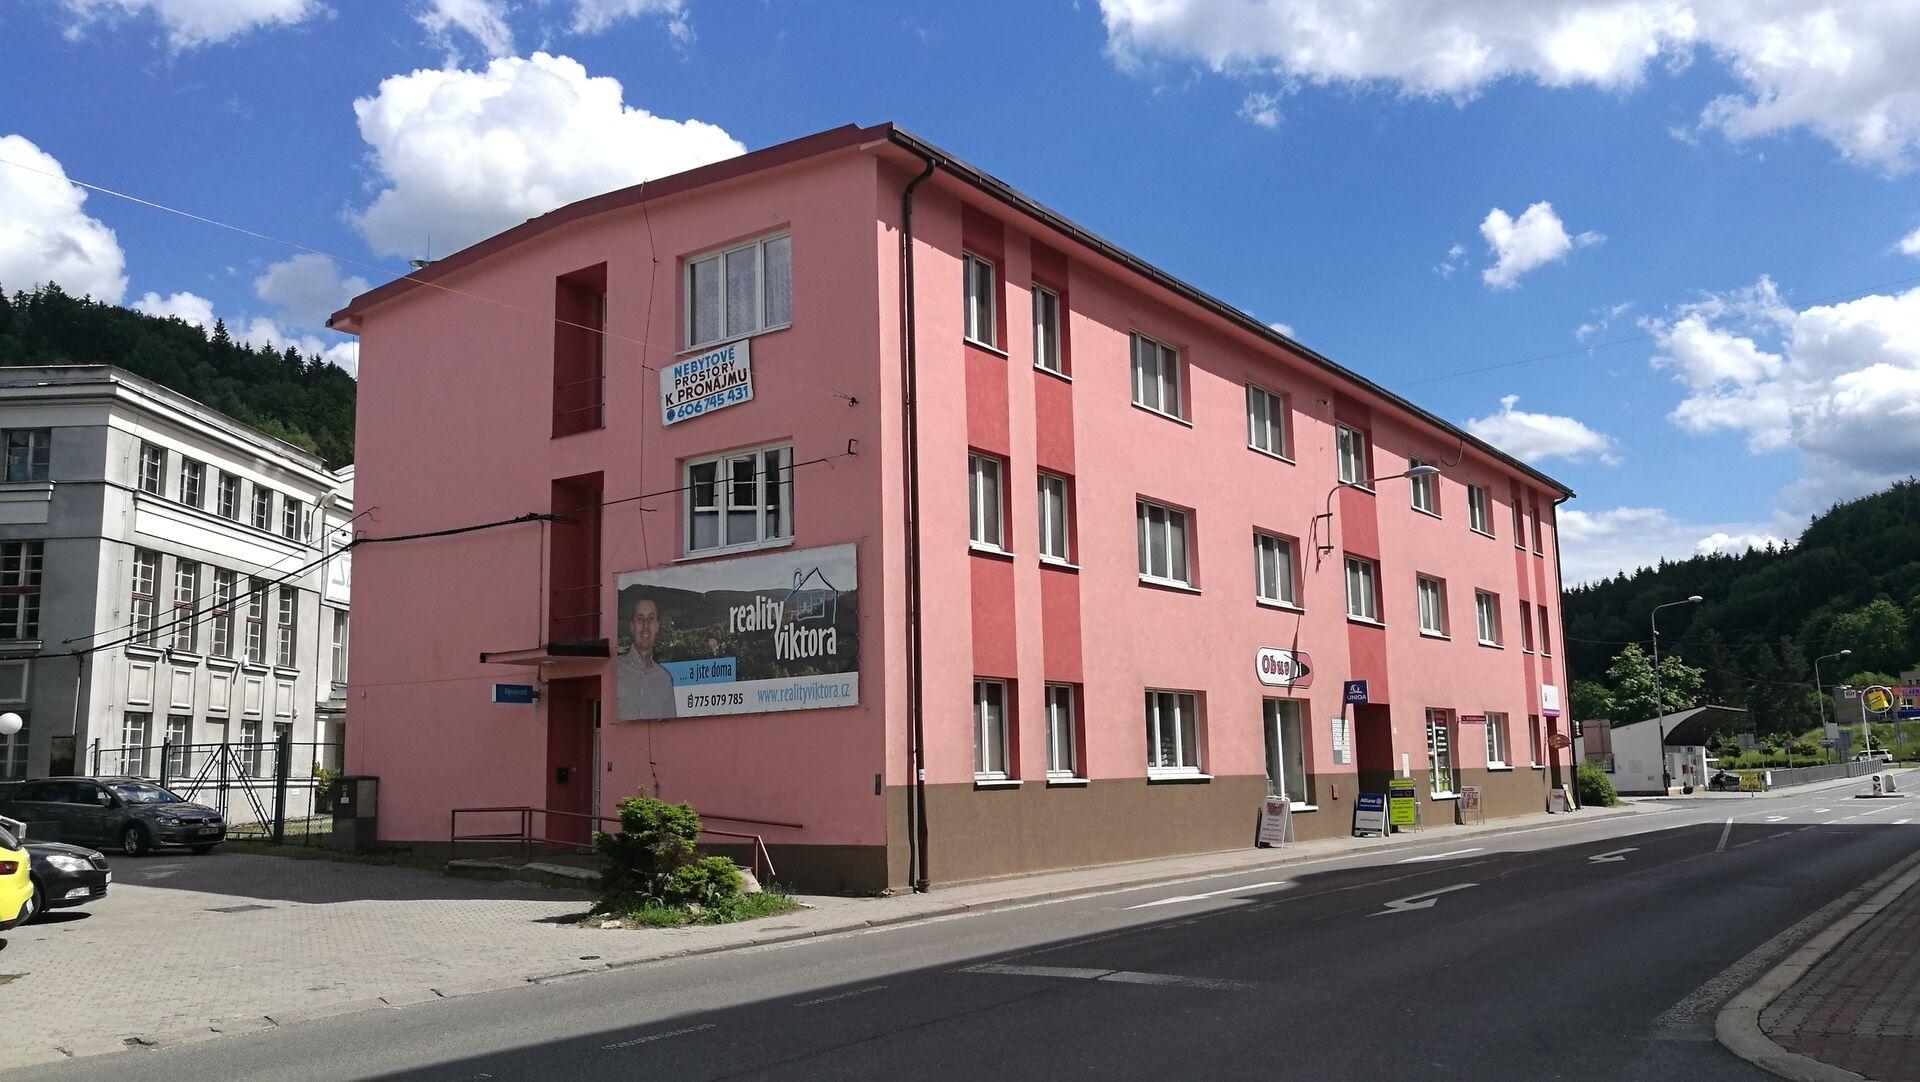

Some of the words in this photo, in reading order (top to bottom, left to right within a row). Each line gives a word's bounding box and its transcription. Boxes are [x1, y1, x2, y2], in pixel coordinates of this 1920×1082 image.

[675, 360, 735, 389] PROSTORY
[665, 393, 674, 406] K
[677, 401, 703, 418] 606
[704, 393, 725, 409] 745
[727, 385, 748, 401] 431
[729, 595, 784, 635] reality
[774, 622, 837, 660] viktora
[689, 670, 694, 679] a
[696, 664, 709, 681] jste
[711, 662, 732, 678] doma
[694, 696, 709, 707] 775
[711, 694, 726, 706] 079
[729, 693, 743, 705] 785
[757, 682, 850, 705] www.realityviktora.cz
[1346, 693, 1367, 701] UNIQA
